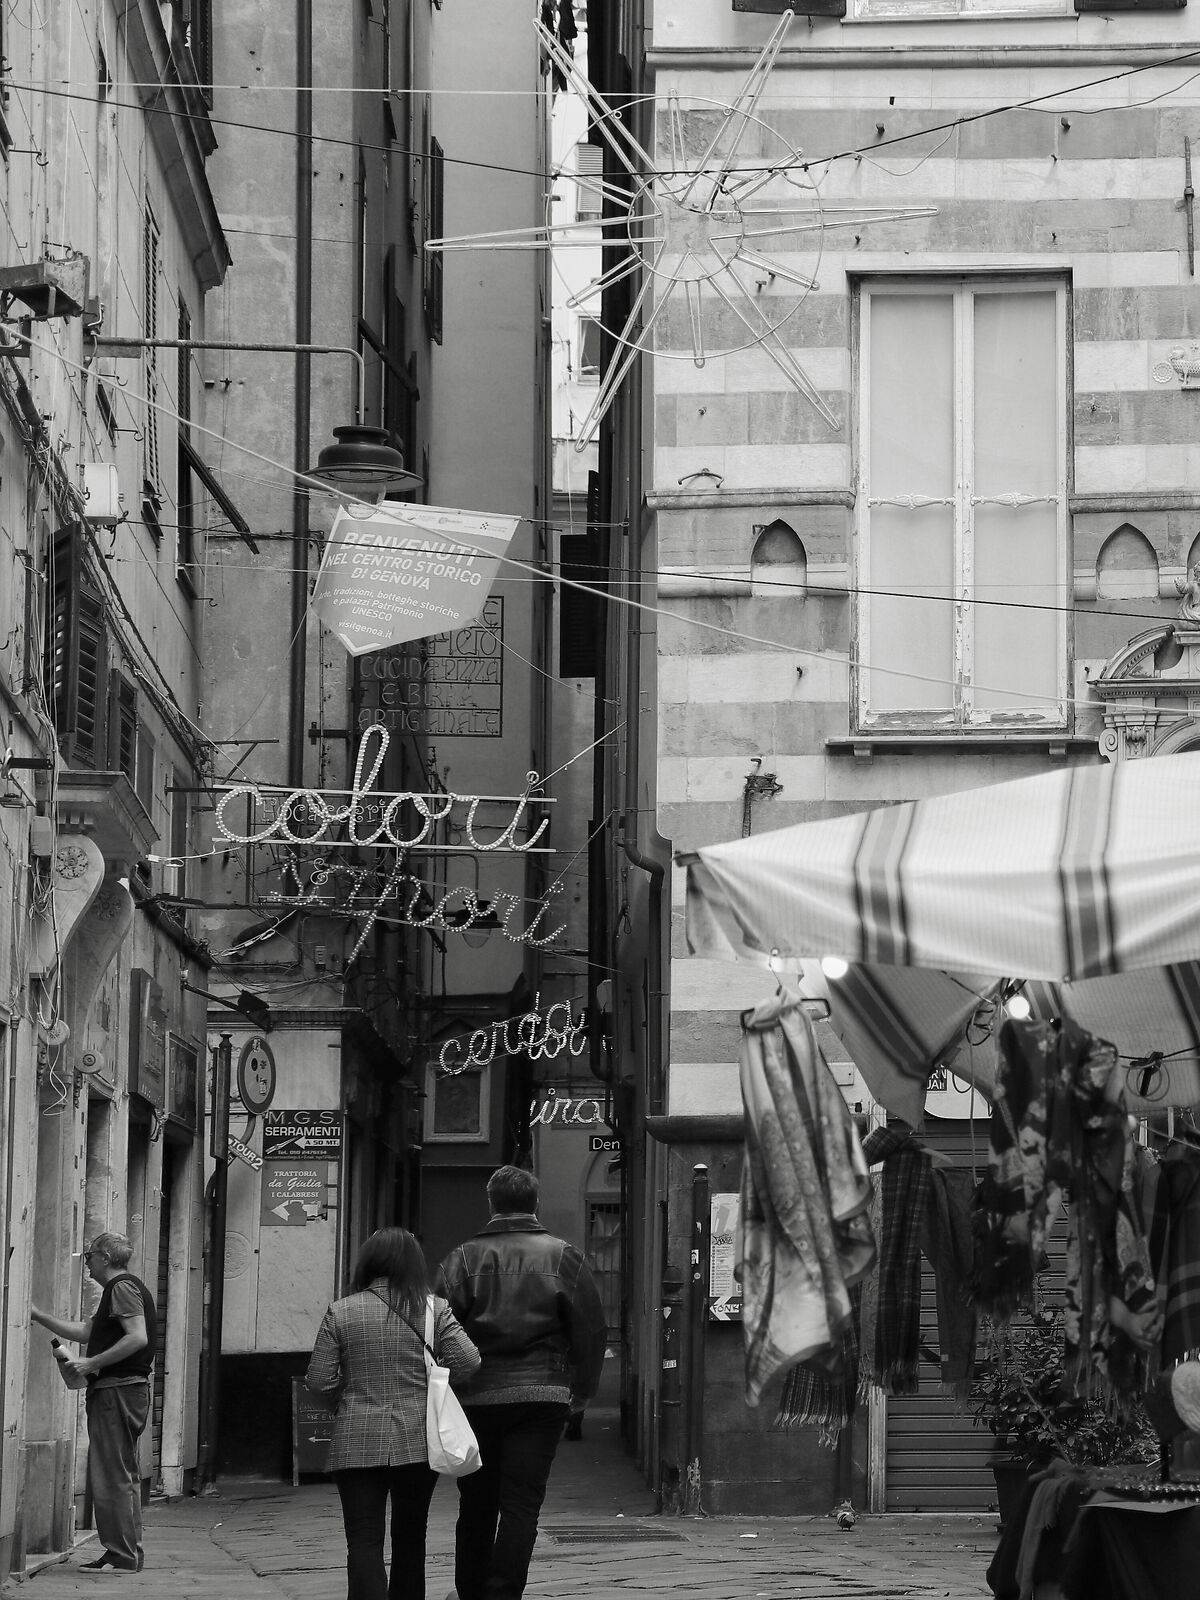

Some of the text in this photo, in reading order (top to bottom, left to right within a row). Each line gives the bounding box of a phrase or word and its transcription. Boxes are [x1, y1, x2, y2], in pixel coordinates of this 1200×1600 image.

[340, 532, 479, 567] BENVENUTI
[325, 552, 483, 587] NEL CENTRO STORICO
[351, 567, 431, 591] DI GENOVA
[333, 587, 375, 599] tradizioni,
[376, 589, 420, 609] botteghe
[419, 599, 461, 621] storiche
[338, 597, 371, 609] palazzi
[371, 599, 425, 621] Patrimonio
[351, 606, 394, 623] UNESCO
[337, 619, 395, 640] visitgenoa.it
[215, 723, 550, 852] colori
[268, 1111, 340, 1125] M.G.S.
[264, 1126, 341, 1137] SERRAMENTI
[268, 1177, 323, 1191] da Giulia
